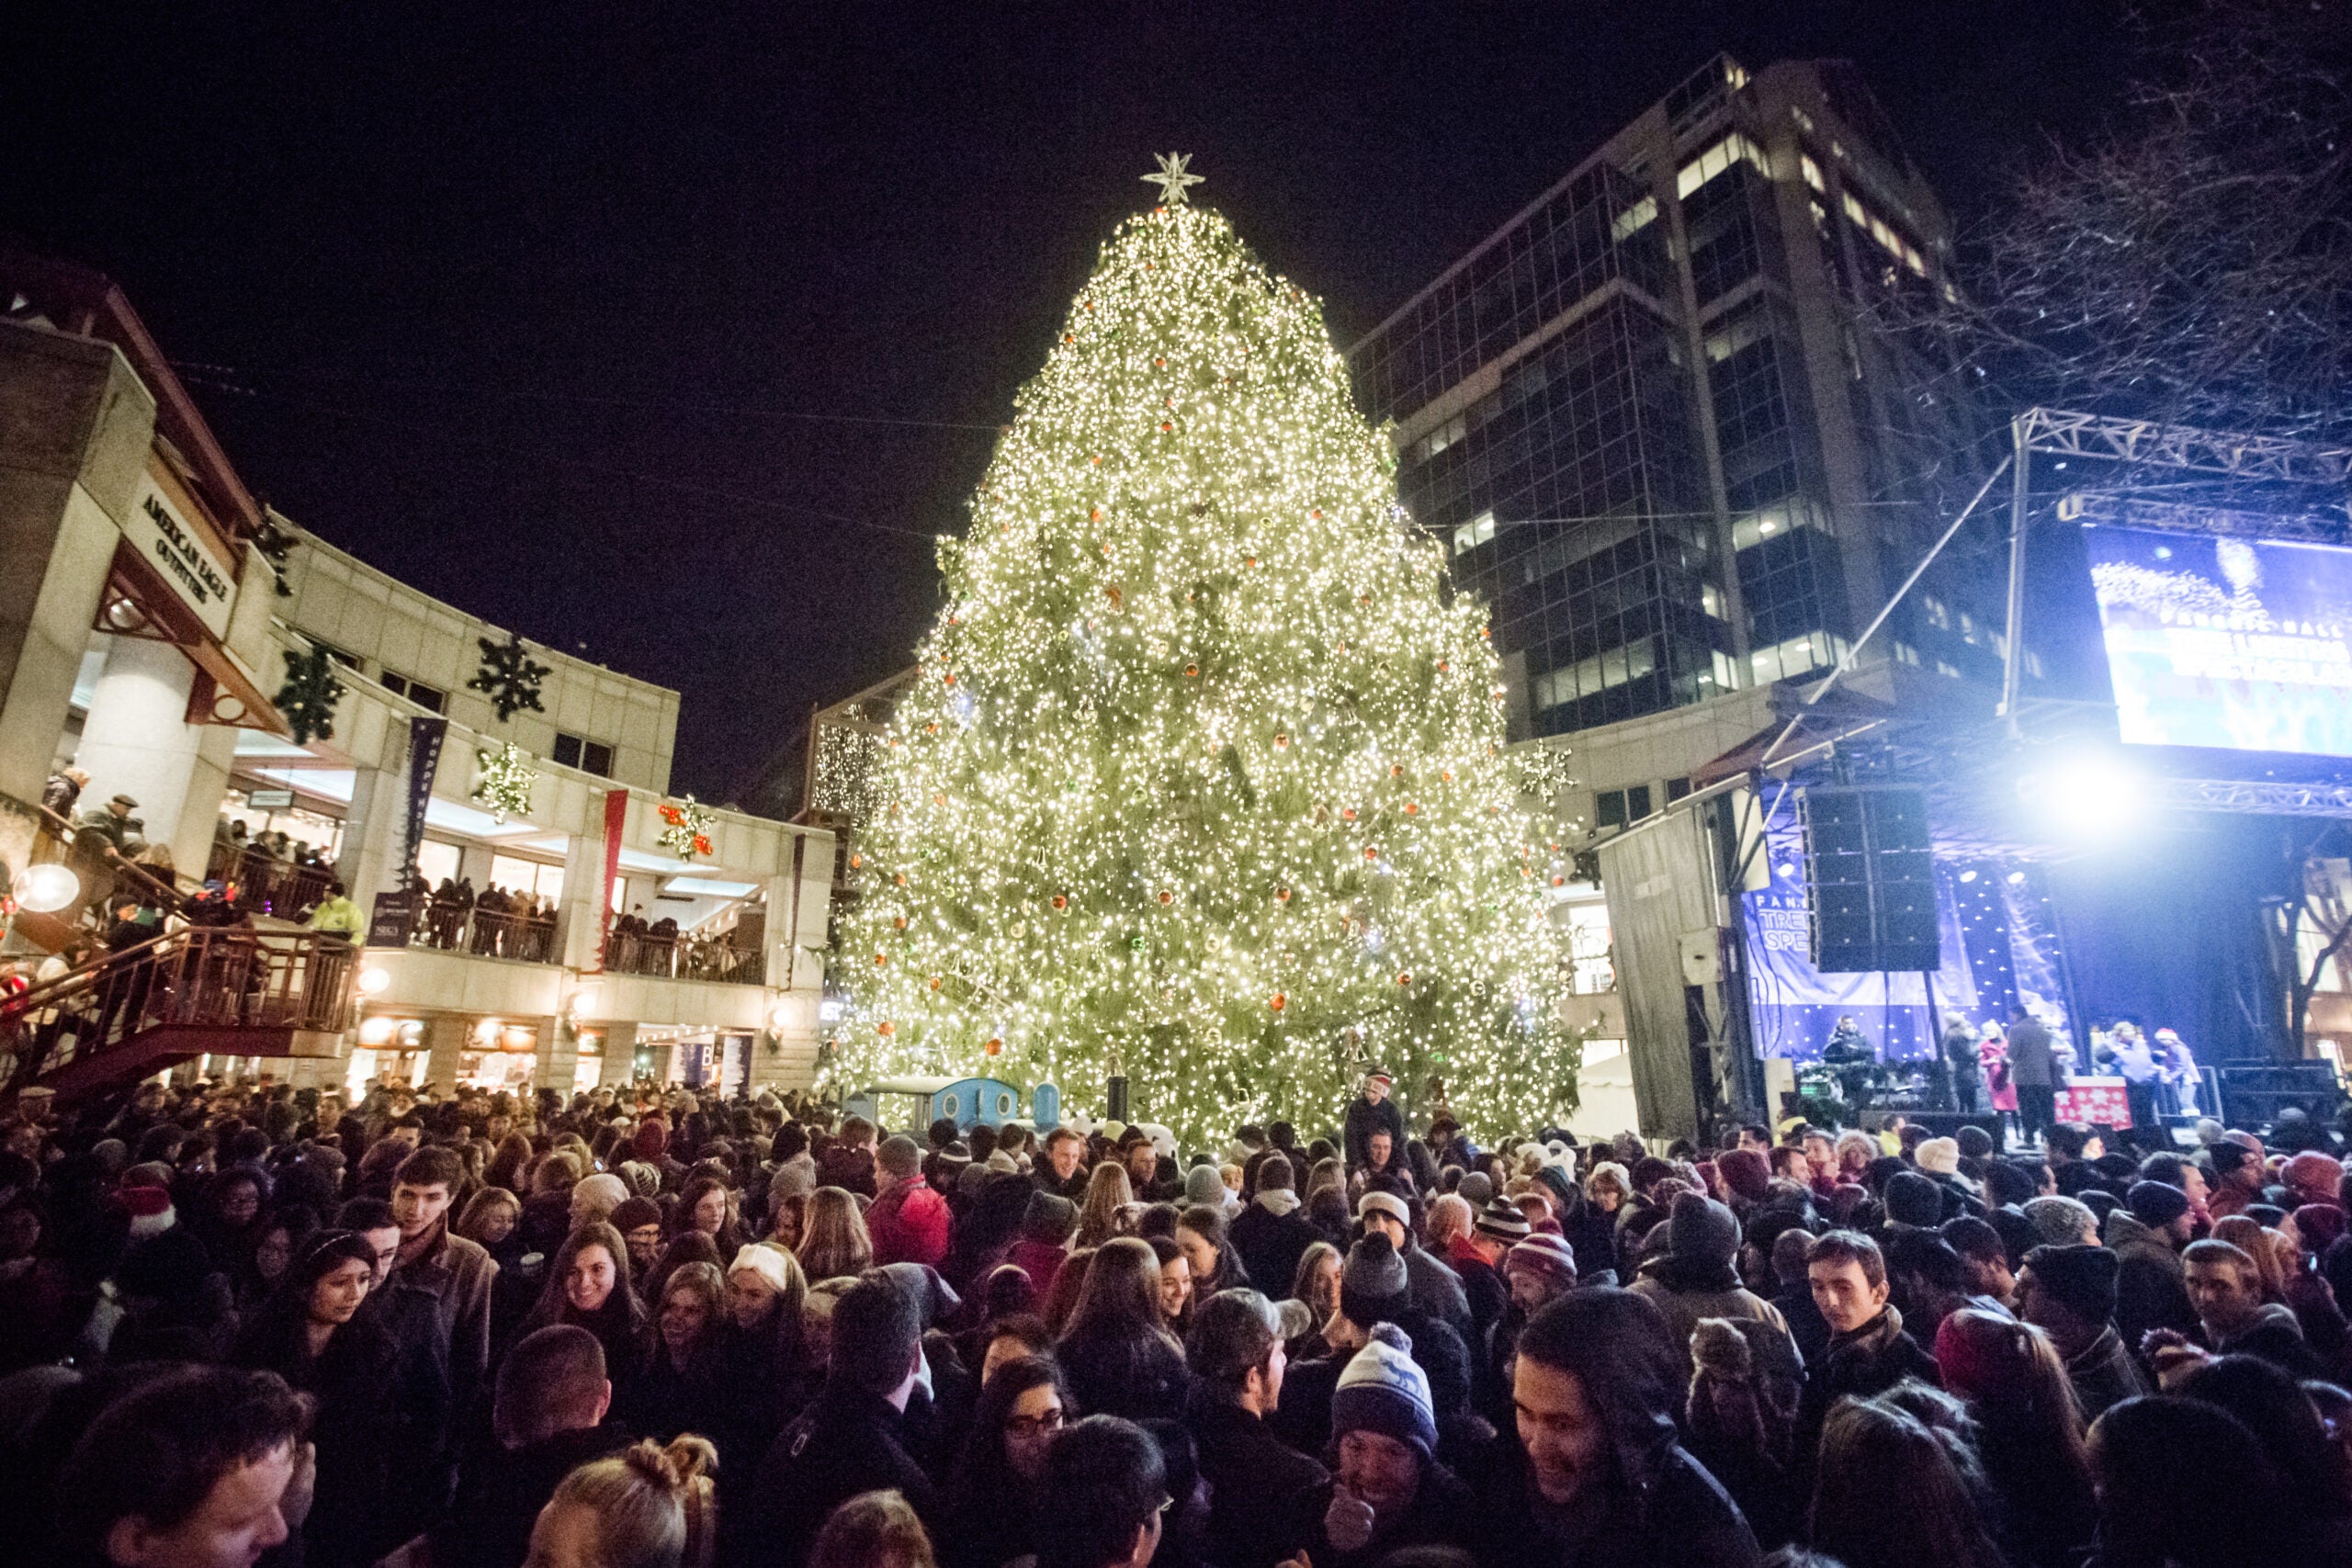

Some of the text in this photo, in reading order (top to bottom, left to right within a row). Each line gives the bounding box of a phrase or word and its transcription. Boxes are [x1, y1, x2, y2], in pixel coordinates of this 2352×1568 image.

[143, 493, 228, 603] AMERICAN EAGLE
[156, 539, 208, 604] OUTFITTERS
[2283, 621, 2344, 638] HALL
[1758, 908, 1808, 930] TRE
[1764, 930, 1808, 952] SPE
